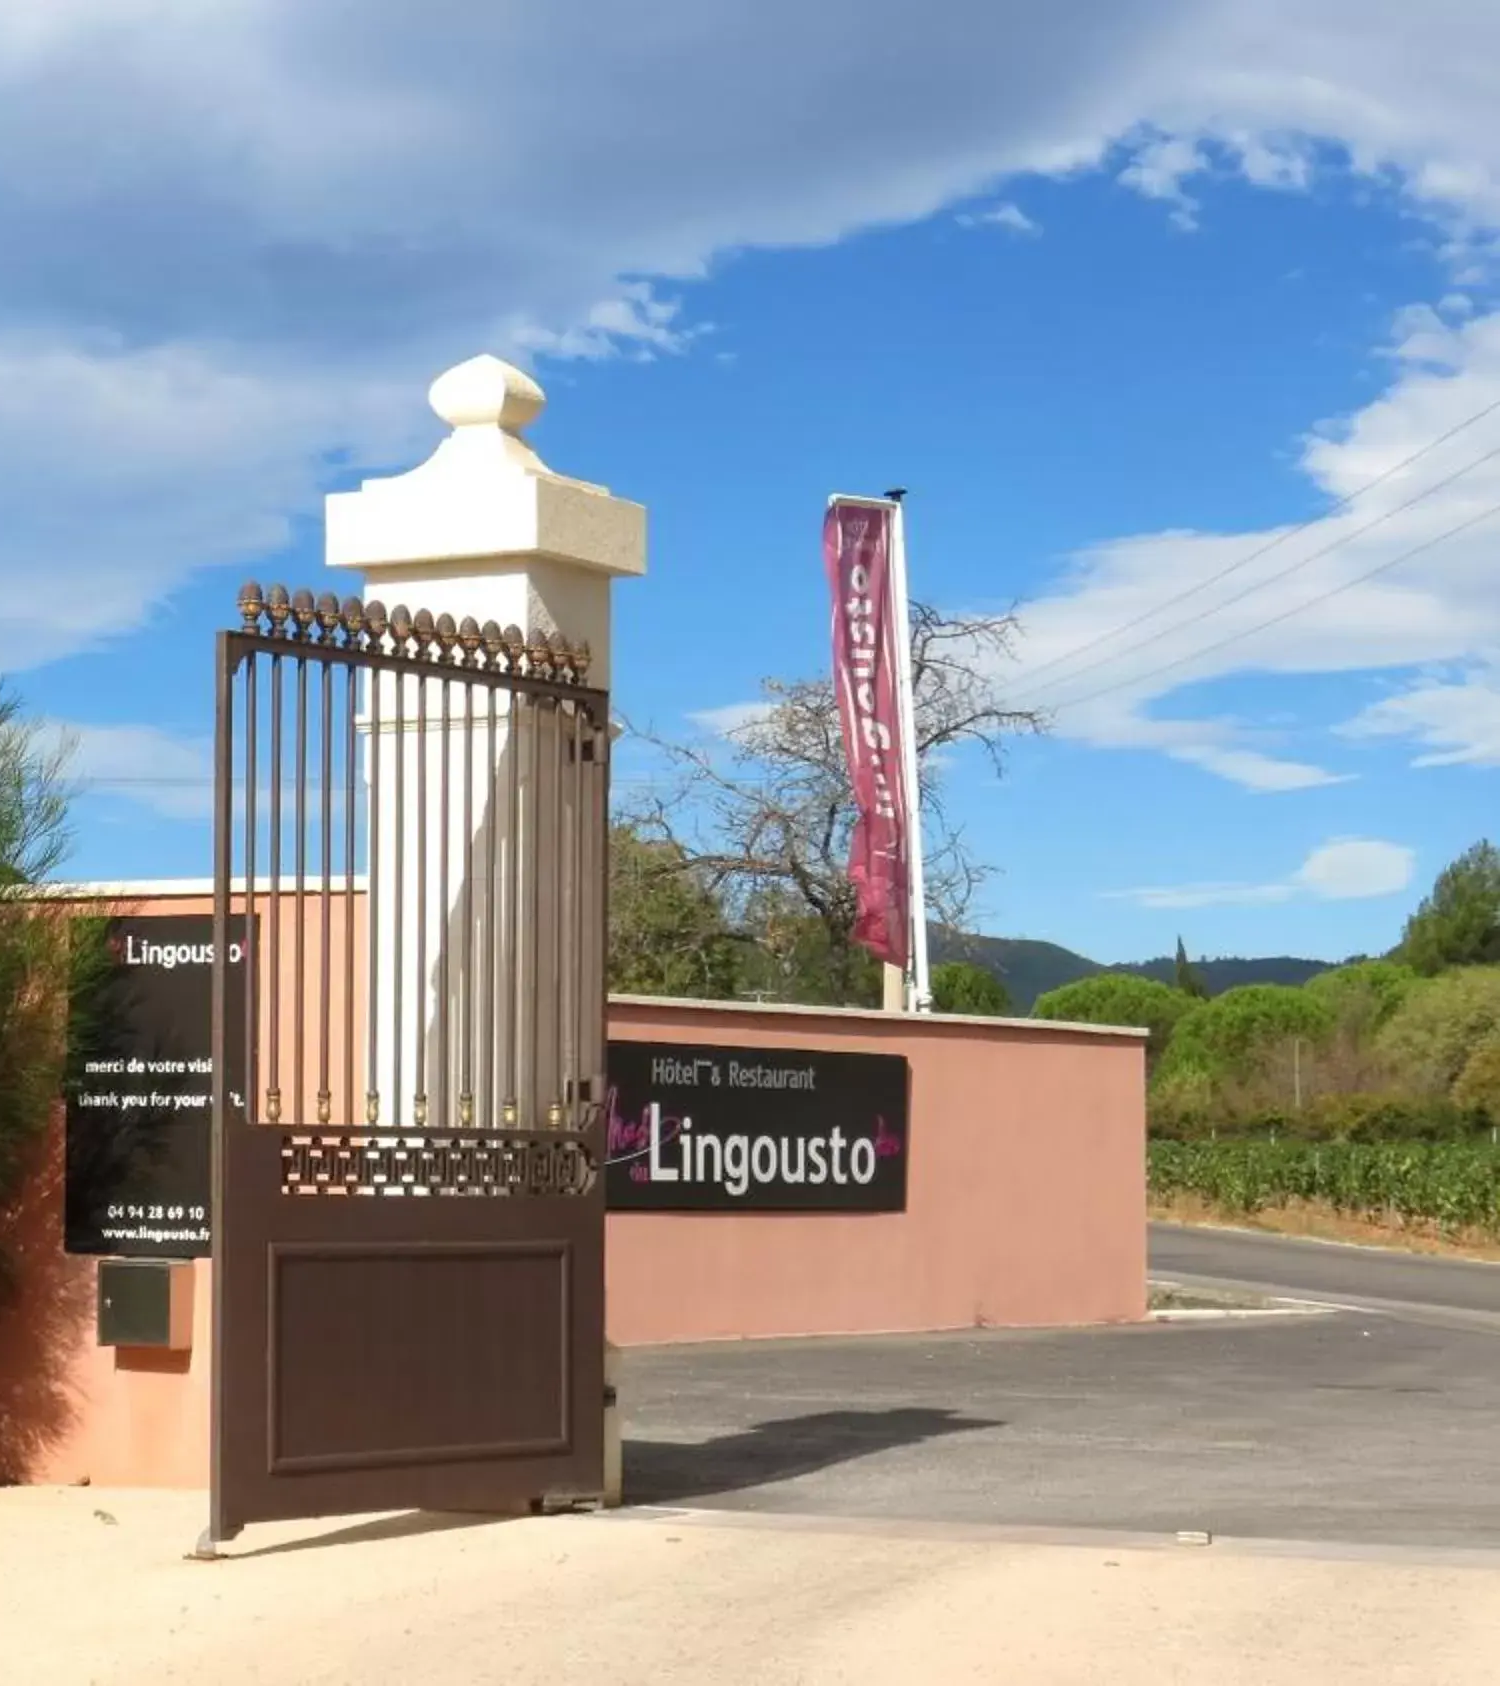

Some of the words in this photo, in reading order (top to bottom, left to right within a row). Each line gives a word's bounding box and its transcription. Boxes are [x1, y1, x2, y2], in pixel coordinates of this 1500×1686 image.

[126, 934, 242, 969] Lingouso
[85, 1058, 125, 1073] merci
[126, 1057, 145, 1073] de
[147, 1058, 186, 1073] votre
[651, 1056, 699, 1086] Hôtel
[728, 1059, 816, 1090] Restaurant
[78, 1091, 119, 1107] thank
[121, 1094, 148, 1111] you
[150, 1091, 171, 1107] for
[173, 1094, 207, 1111] your
[650, 1101, 877, 1197] Lingousto
[107, 1204, 125, 1219] 04
[127, 1204, 145, 1219] 94
[147, 1205, 164, 1220] 28
[167, 1205, 184, 1221] 69
[188, 1205, 205, 1221] 10
[101, 1225, 211, 1244] www.lingousto.fr
